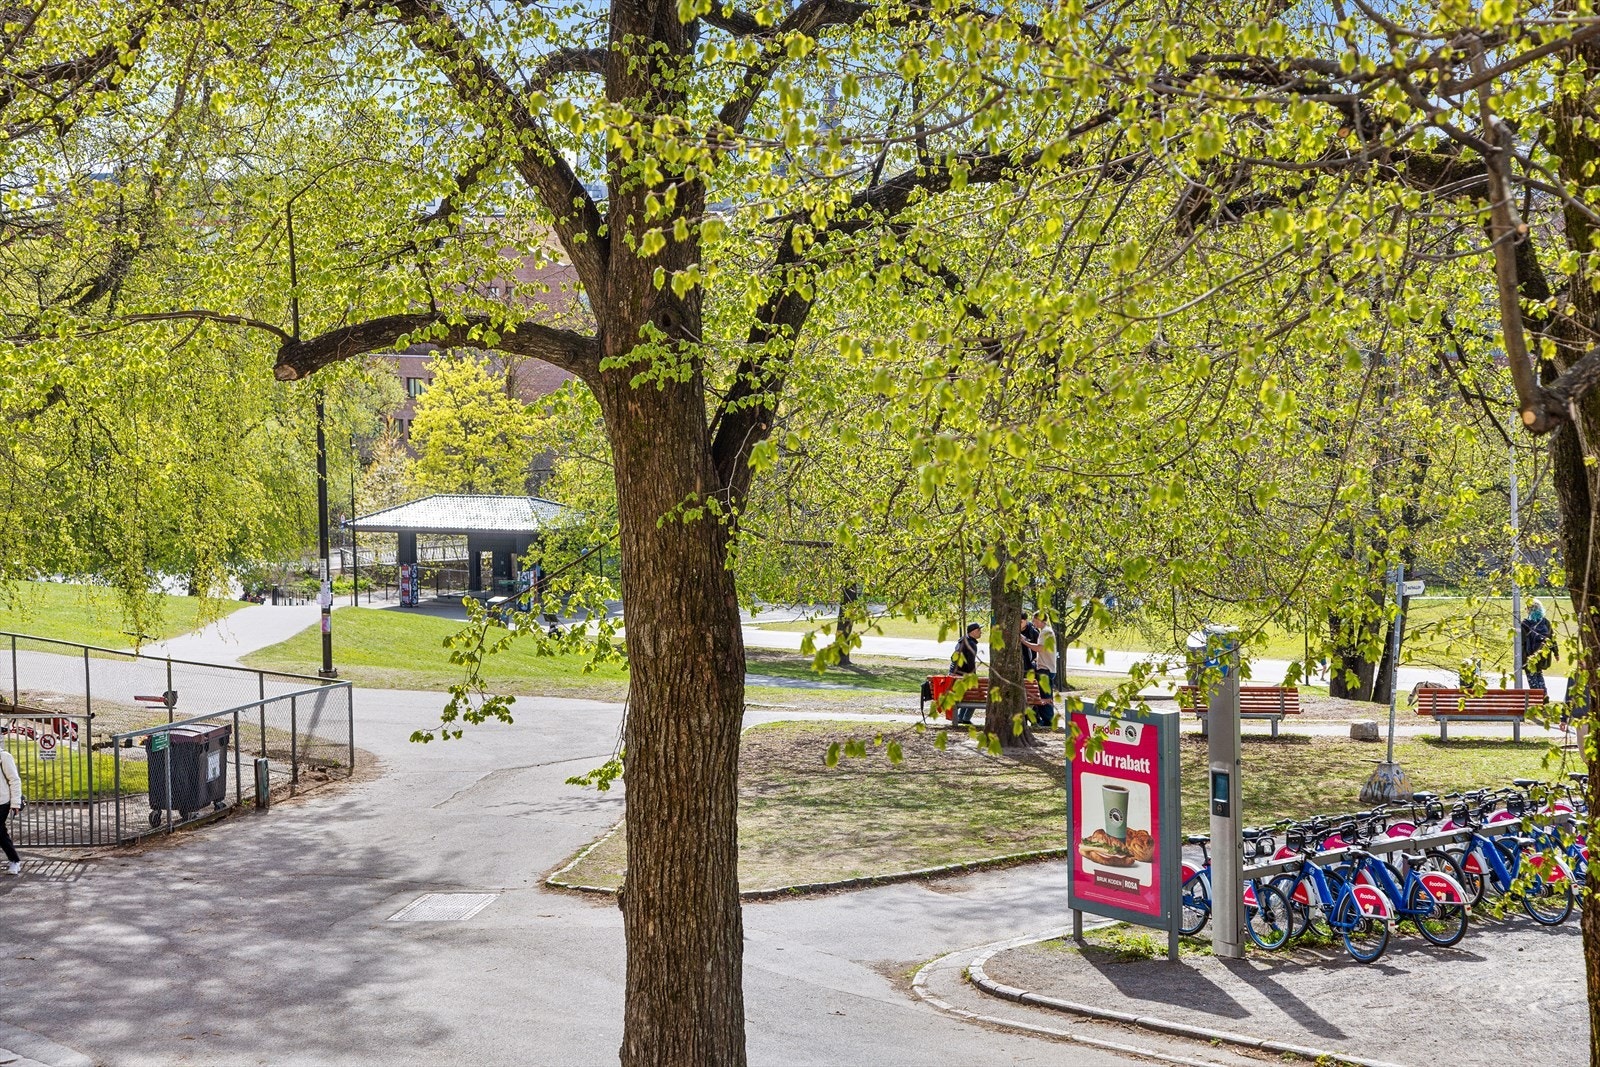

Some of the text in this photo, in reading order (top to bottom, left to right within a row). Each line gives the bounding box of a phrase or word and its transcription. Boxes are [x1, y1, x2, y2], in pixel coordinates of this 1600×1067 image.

[1102, 750, 1114, 767] kr
[1115, 754, 1150, 774] rabatt
[1096, 875, 1138, 890] BRUK KODEN ROSA
[1360, 892, 1376, 900] foodora
